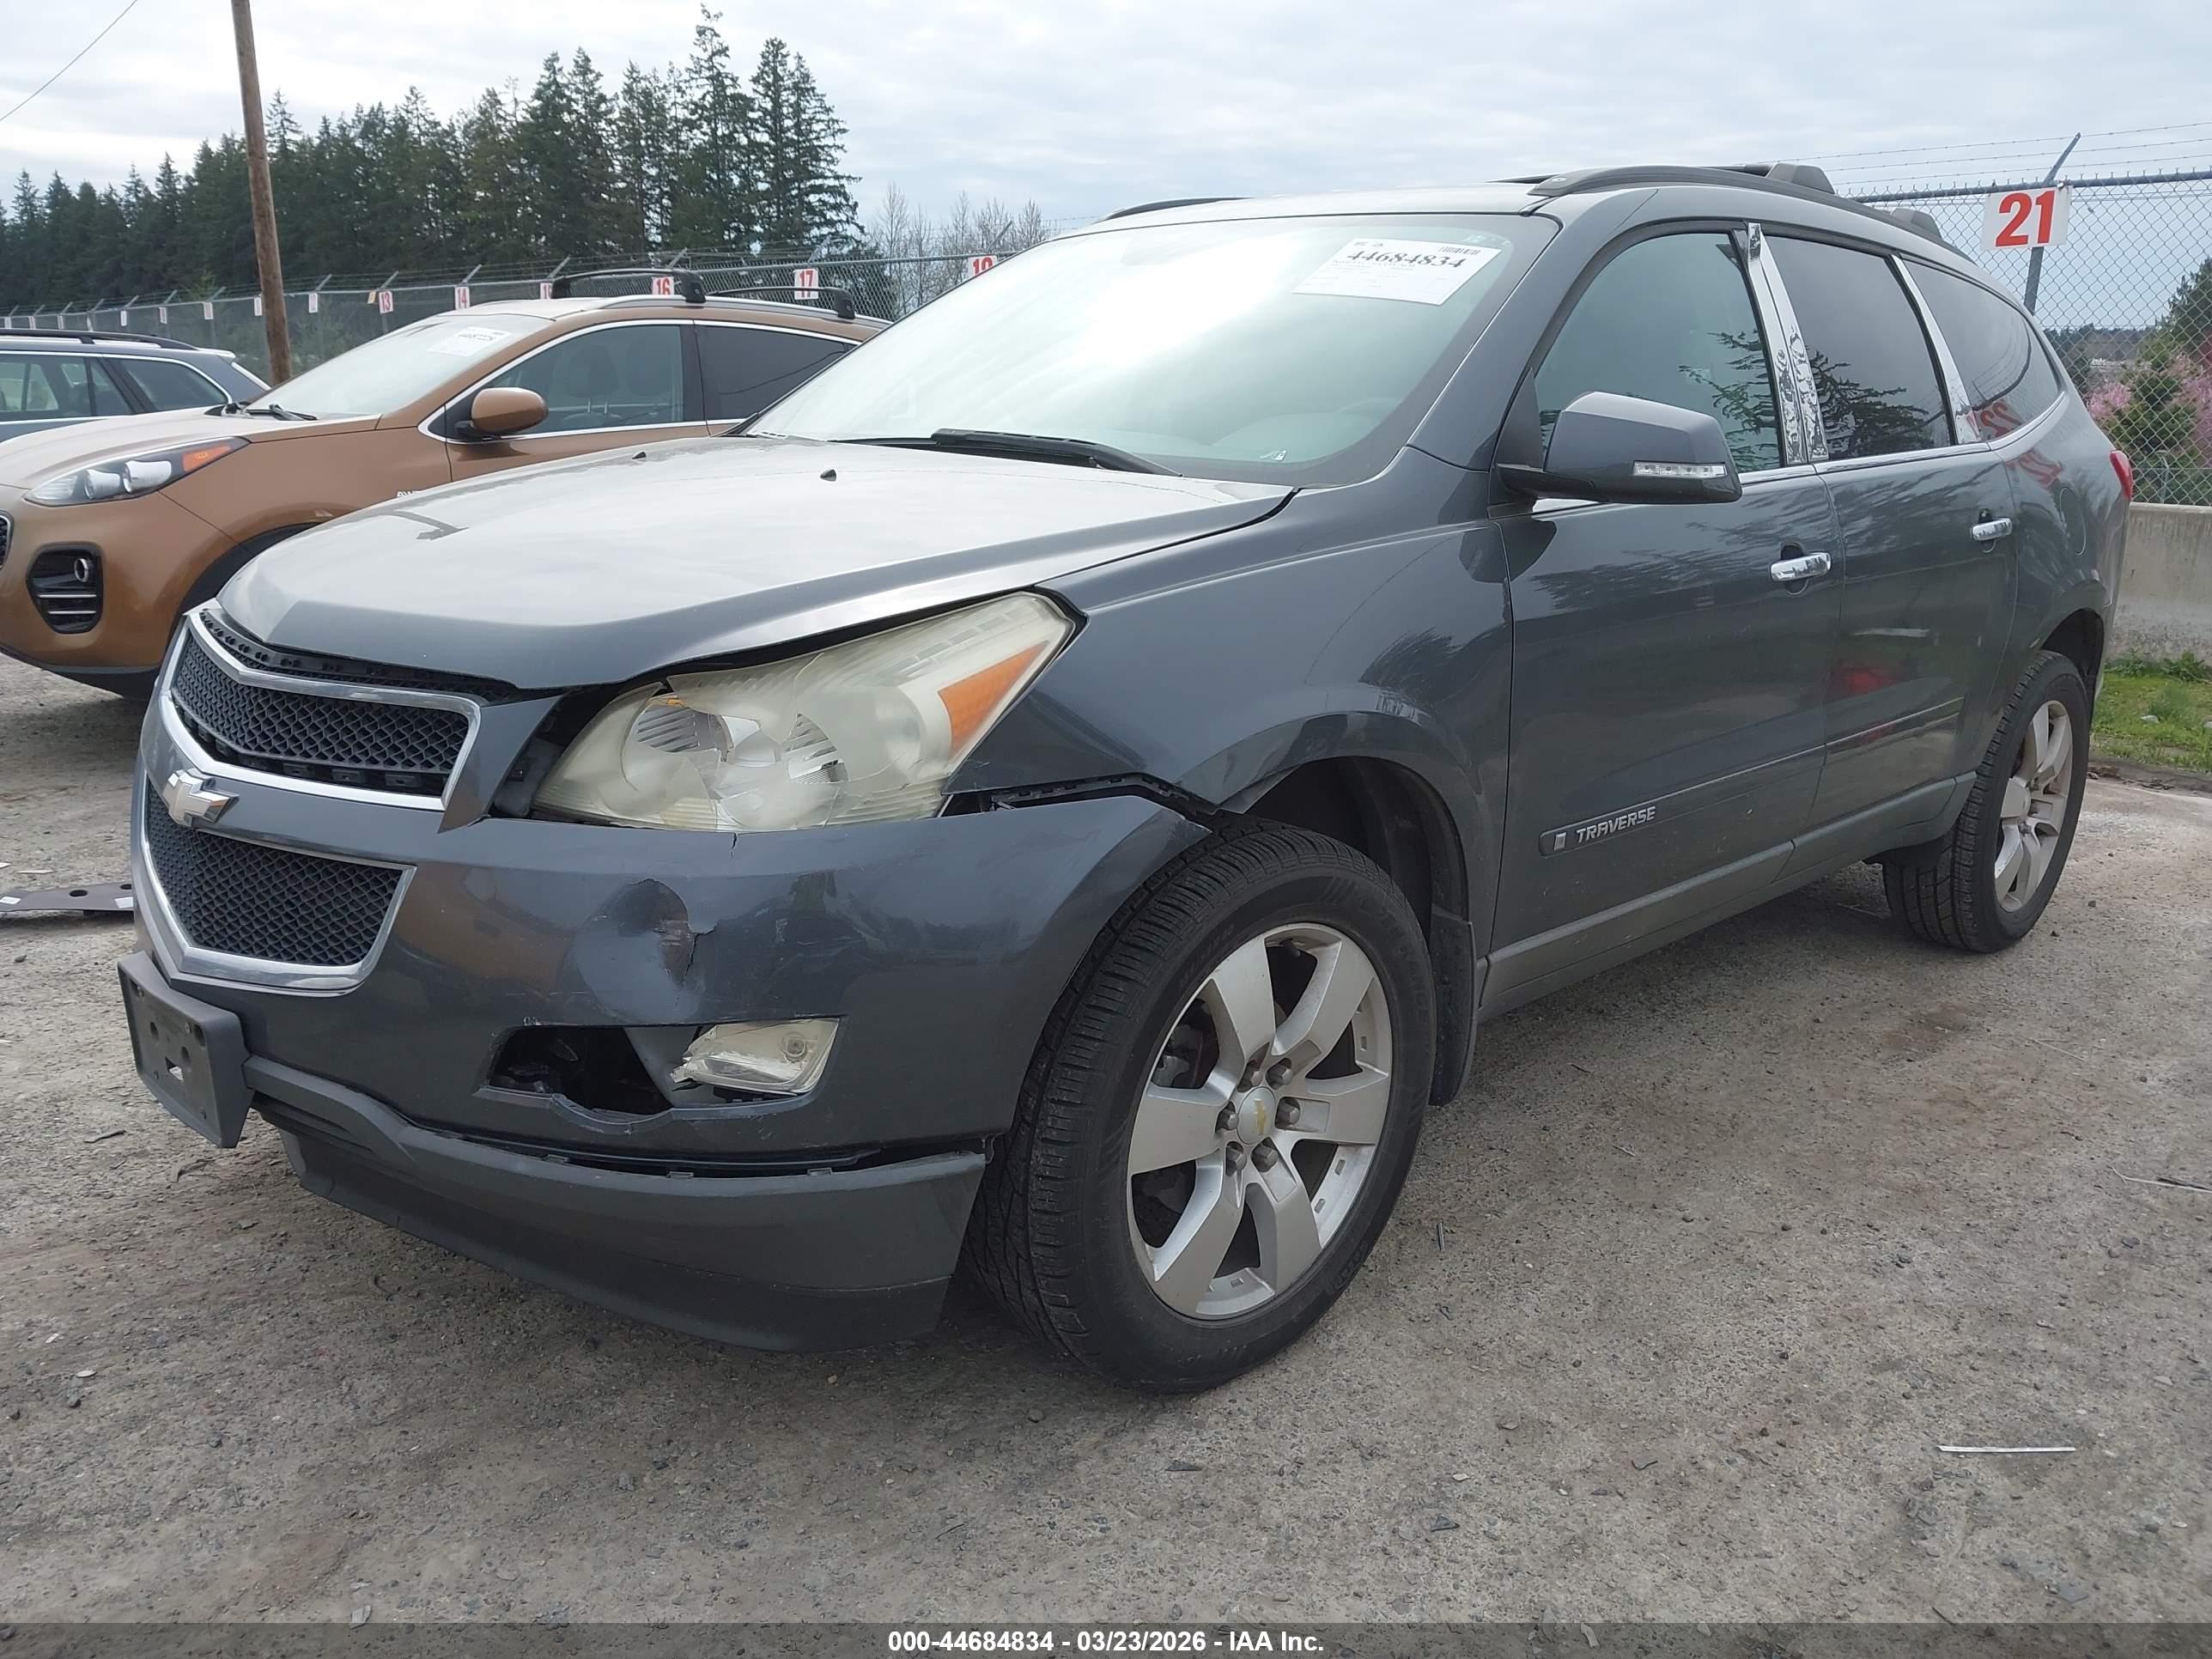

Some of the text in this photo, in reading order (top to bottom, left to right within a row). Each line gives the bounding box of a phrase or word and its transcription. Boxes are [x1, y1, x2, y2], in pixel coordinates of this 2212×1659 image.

[1995, 190, 2056, 247] 21
[1346, 250, 1467, 268] 44684834
[655, 276, 671, 295] 16
[799, 270, 813, 298] 17
[381, 291, 392, 312] 13
[458, 288, 467, 309] 14
[1577, 805, 1656, 844] TRAVERSE
